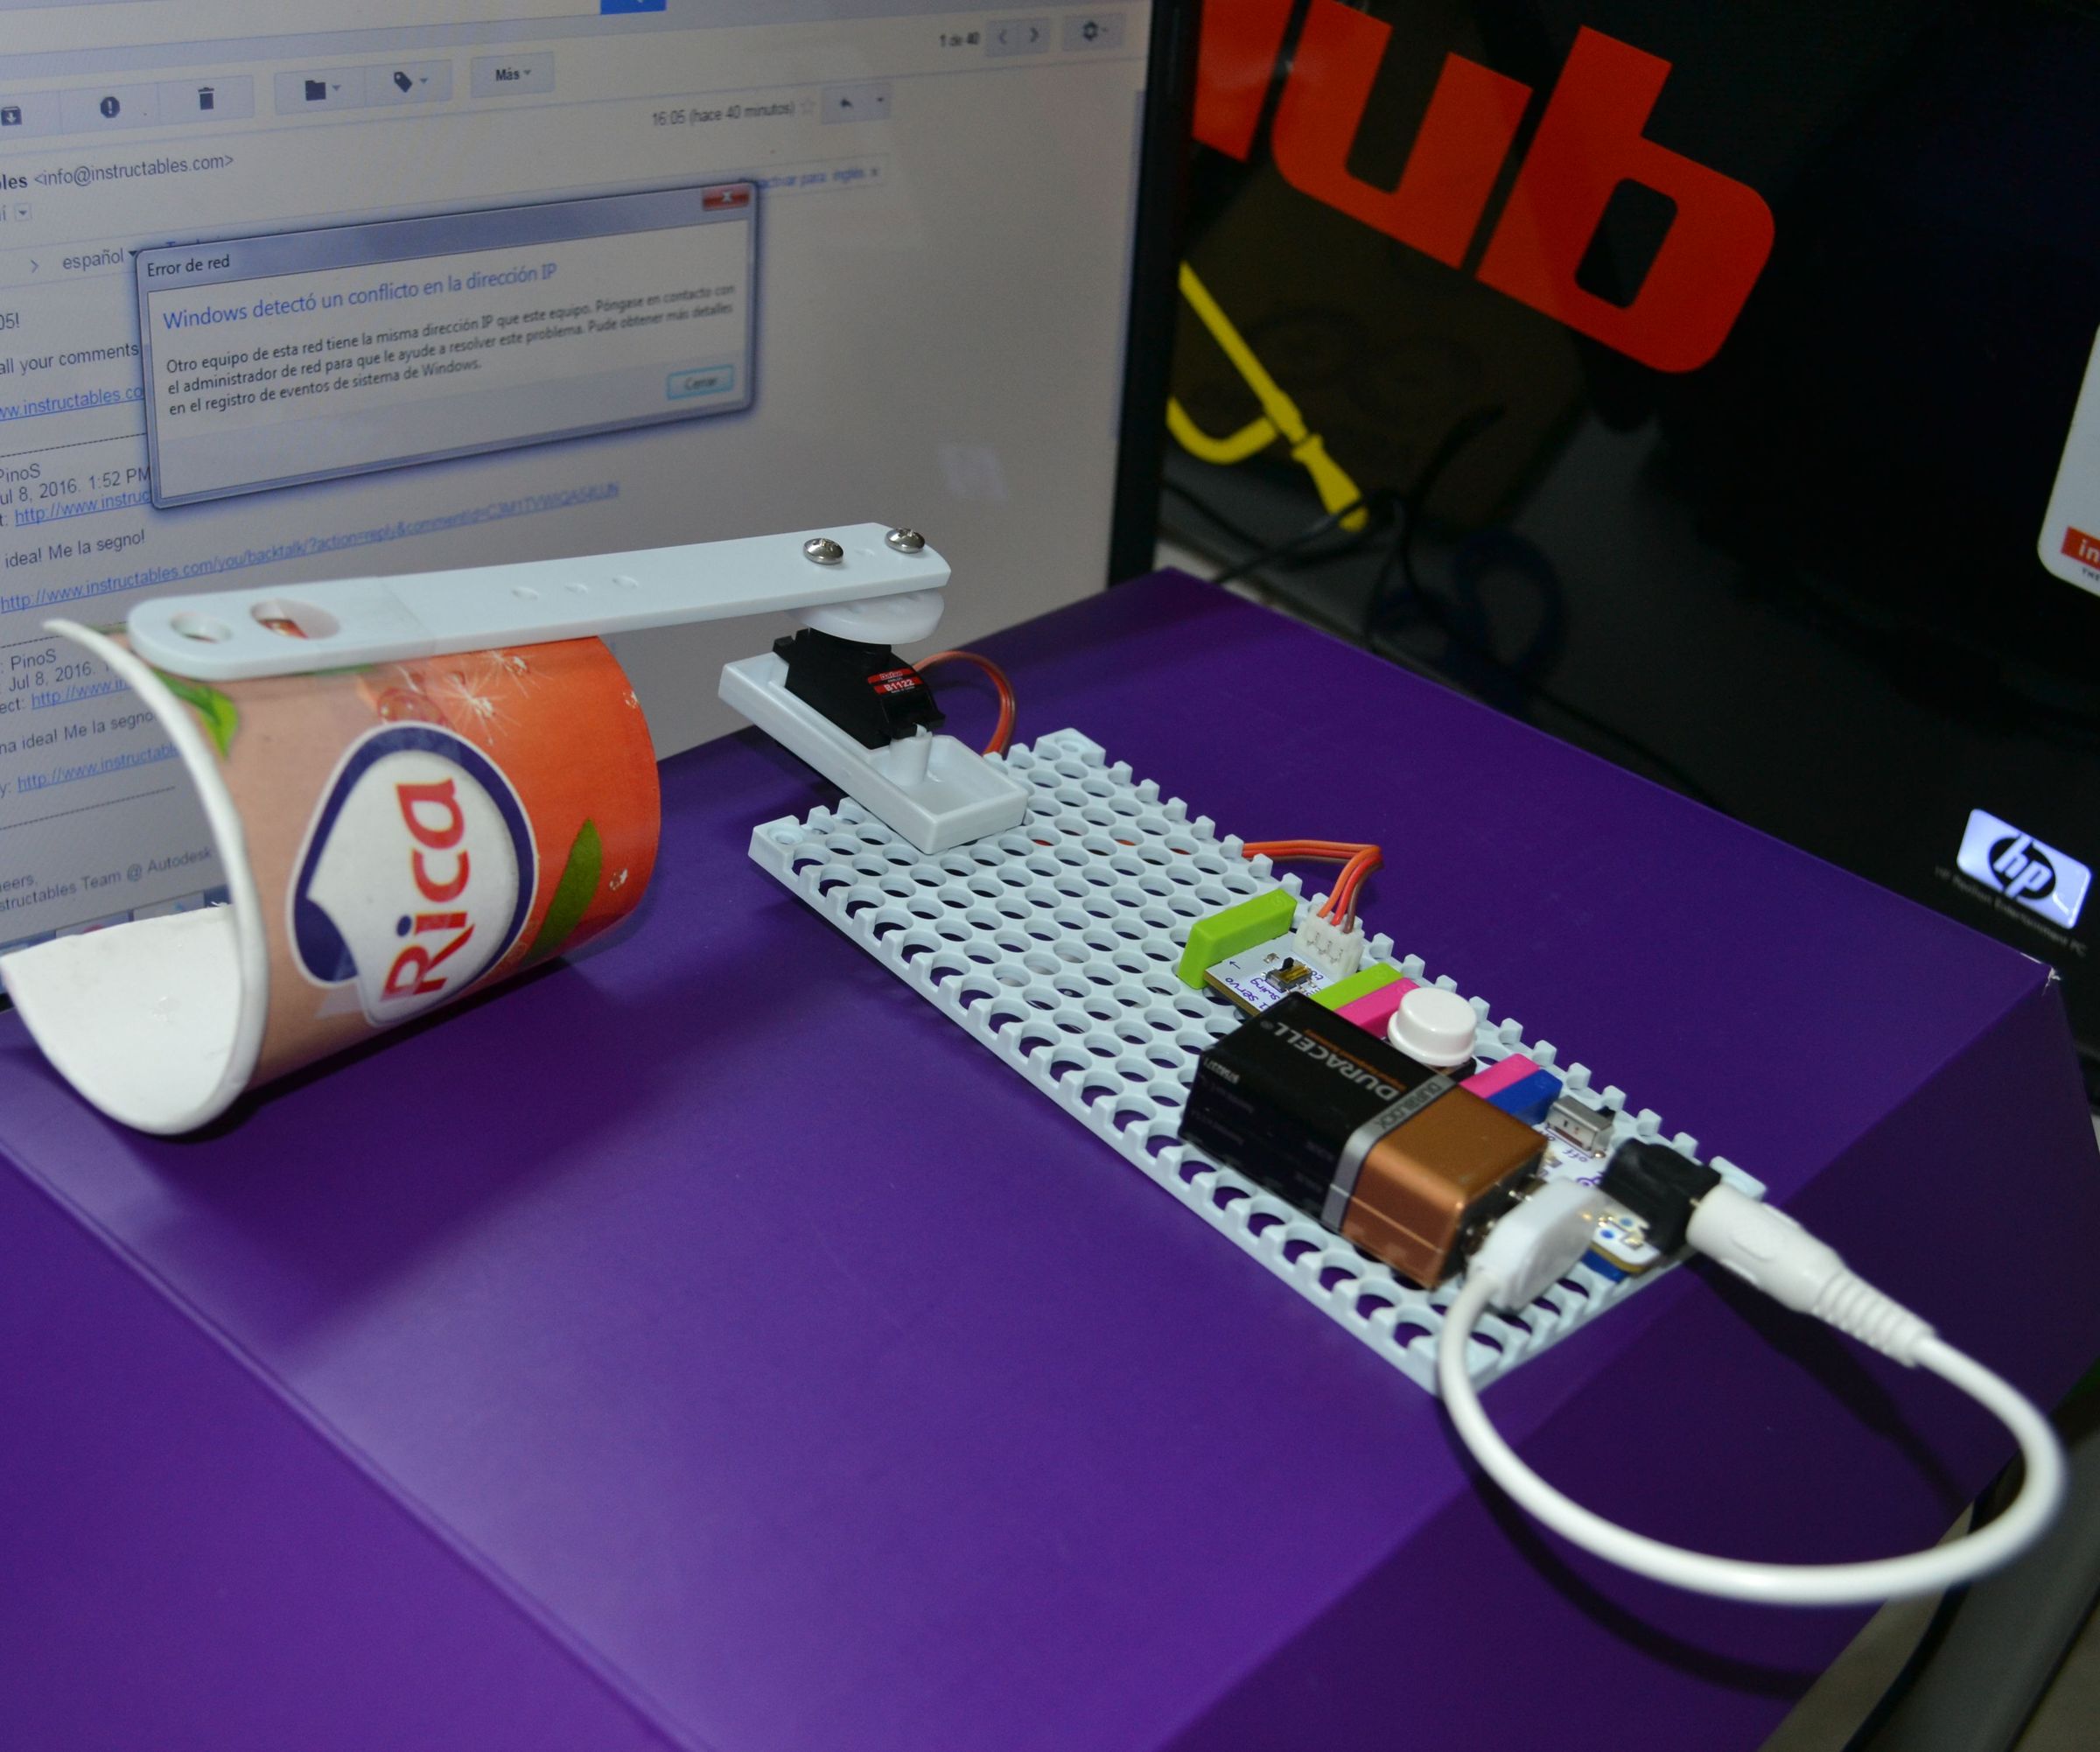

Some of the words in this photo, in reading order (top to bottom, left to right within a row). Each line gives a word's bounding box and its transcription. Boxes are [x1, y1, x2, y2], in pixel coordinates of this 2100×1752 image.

[494, 67, 520, 81] Más
[727, 104, 741, 120] 40
[745, 101, 795, 117] minutos)
[34, 154, 234, 186] <info@instructables.com>
[62, 248, 124, 274] español
[147, 263, 181, 277] Error
[186, 258, 204, 273] de
[207, 254, 230, 270] red
[163, 306, 248, 330] Windows
[253, 292, 317, 318] detectó
[321, 293, 343, 309] un
[347, 282, 419, 305] conflicto
[424, 280, 444, 296] en
[447, 275, 462, 292] la
[466, 266, 538, 291] dirección
[541, 262, 557, 280] IP
[166, 358, 197, 374] Otro
[201, 350, 248, 370] equipo
[253, 347, 270, 361] de
[273, 343, 298, 358] esta
[302, 339, 323, 354] red
[326, 335, 358, 350] tiene
[361, 332, 373, 346] la
[376, 327, 418, 344] misma
[422, 318, 479, 338] dirección
[482, 314, 494, 329] IP
[497, 314, 519, 330] que
[522, 308, 545, 323] este
[550, 305, 592, 322] equipo.
[595, 296, 645, 314] Póngase
[647, 294, 661, 305] en
[663, 286, 711, 304] contacto
[715, 284, 735, 297] con
[20, 355, 53, 376] your
[59, 343, 140, 366] comments
[168, 381, 179, 395] el
[184, 367, 277, 393] administrador
[281, 364, 298, 378] de
[301, 360, 321, 375] red
[326, 357, 353, 375] para
[357, 354, 381, 370] que
[384, 349, 395, 363] le
[398, 344, 436, 363] ayude
[439, 345, 446, 355] a
[449, 336, 495, 353] resolver
[499, 332, 522, 347] este
[526, 324, 584, 345] problema.
[620, 312, 664, 329] obtener
[666, 308, 690, 322] más
[692, 303, 733, 319] detalles
[169, 403, 186, 416] en
[190, 397, 201, 411] el
[205, 392, 256, 412] registro
[260, 387, 276, 402] de
[279, 380, 330, 398] eventos
[334, 376, 349, 390] de
[353, 371, 400, 388] sistema
[403, 366, 418, 380] de
[422, 358, 482, 377] Windows.
[89, 471, 121, 490] 1:52
[126, 466, 151, 484] PM
[5, 547, 42, 568] idea!
[49, 544, 73, 561] Me
[78, 540, 92, 555] la
[96, 528, 145, 552] segno!
[10, 648, 57, 671] PinoS
[9, 674, 30, 692] Jul
[884, 678, 915, 692] B1122
[22, 730, 58, 750] idea!
[64, 724, 88, 741] Me
[93, 721, 106, 734] la
[80, 871, 122, 891] Team
[126, 863, 143, 883] @
[147, 846, 212, 873] Autodesk
[1992, 832, 2053, 899] hp
[380, 778, 475, 1002] Rica
[1225, 977, 1259, 1002] servo
[1250, 977, 1280, 1001] swing
[1273, 1021, 1400, 1102] DURACELL
